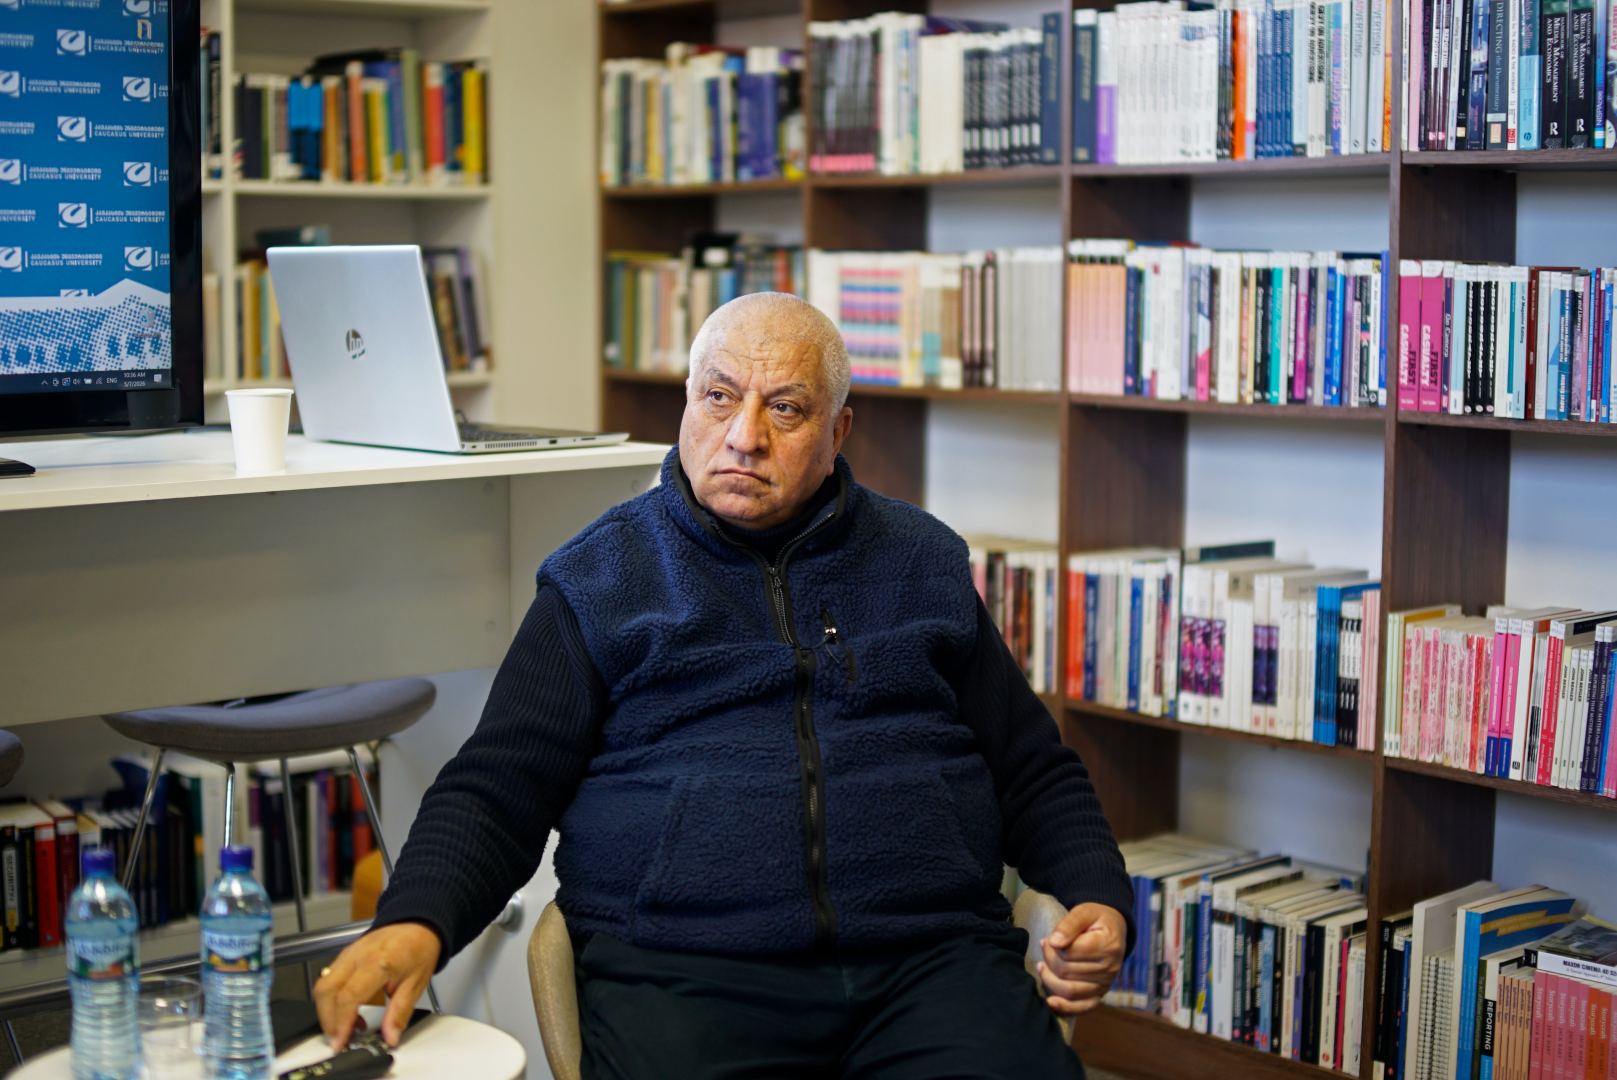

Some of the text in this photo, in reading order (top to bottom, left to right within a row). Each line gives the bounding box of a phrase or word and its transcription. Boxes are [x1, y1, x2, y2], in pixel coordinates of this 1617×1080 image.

[1354, 0, 1364, 57] ADVERTISING
[1424, 46, 1429, 55] OF
[1496, 2, 1504, 53] DIRECTING
[1524, 24, 1532, 49] Selling
[1333, 28, 1342, 130] MEDIA INDUSTRIES
[1493, 68, 1501, 111] Documentary
[1445, 314, 1451, 325] On
[346, 329, 366, 360] hp
[1400, 324, 1408, 386] CASUALTY
[1422, 325, 1430, 386] CASUALTY
[6, 854, 16, 902] SECURITY+
[1563, 960, 1580, 968] MAXON
[1582, 964, 1601, 973] CINEMA
[1484, 1001, 1493, 1050] REPORTING
